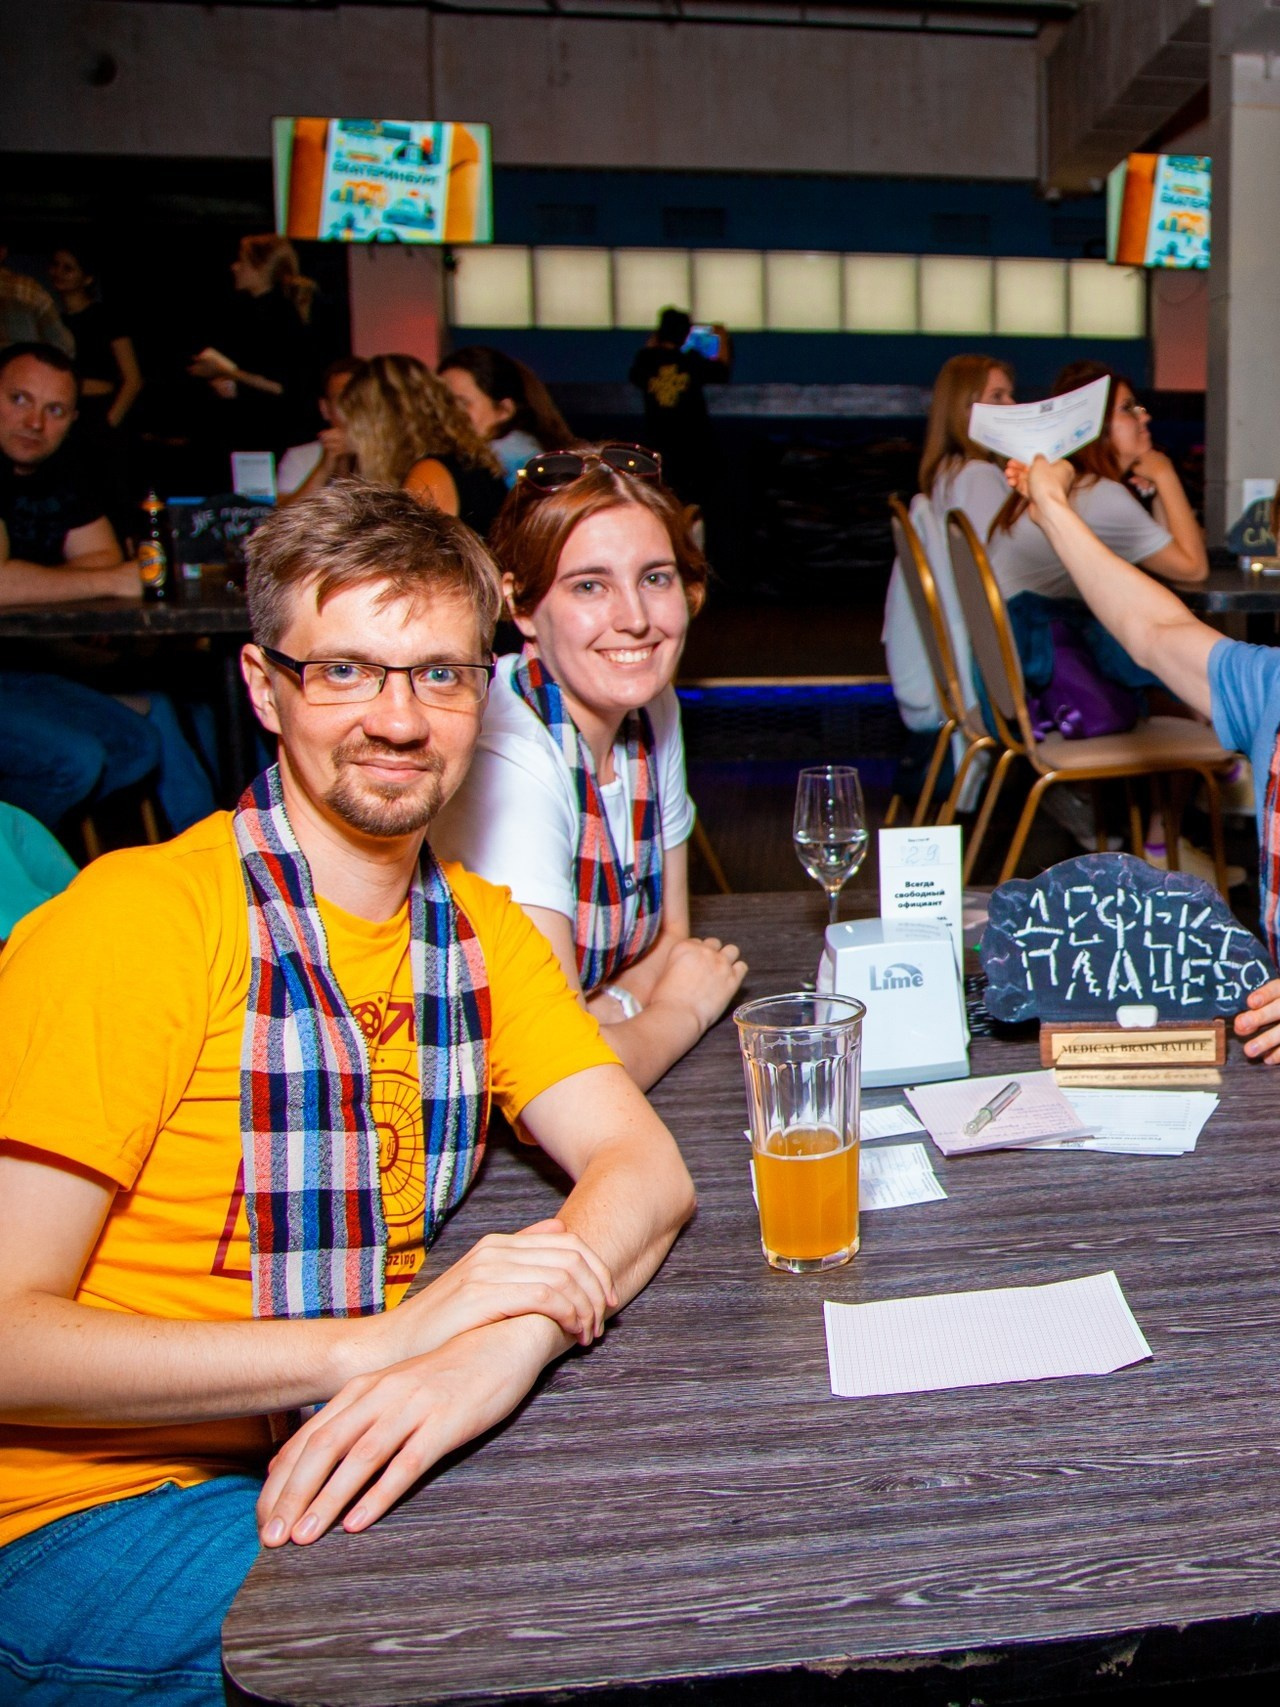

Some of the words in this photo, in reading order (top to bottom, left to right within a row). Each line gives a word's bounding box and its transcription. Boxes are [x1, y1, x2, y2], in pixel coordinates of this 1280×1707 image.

[905, 881, 934, 889] Всегда
[895, 889, 945, 898] свободный
[898, 900, 942, 909] официант
[869, 963, 924, 991] Lime
[1022, 948, 1270, 1005] ПЛАЦЕБО
[1062, 1044, 1116, 1054] MEDICAL
[1120, 1043, 1159, 1053] BRAIN
[1161, 1042, 1208, 1052] BATTLE
